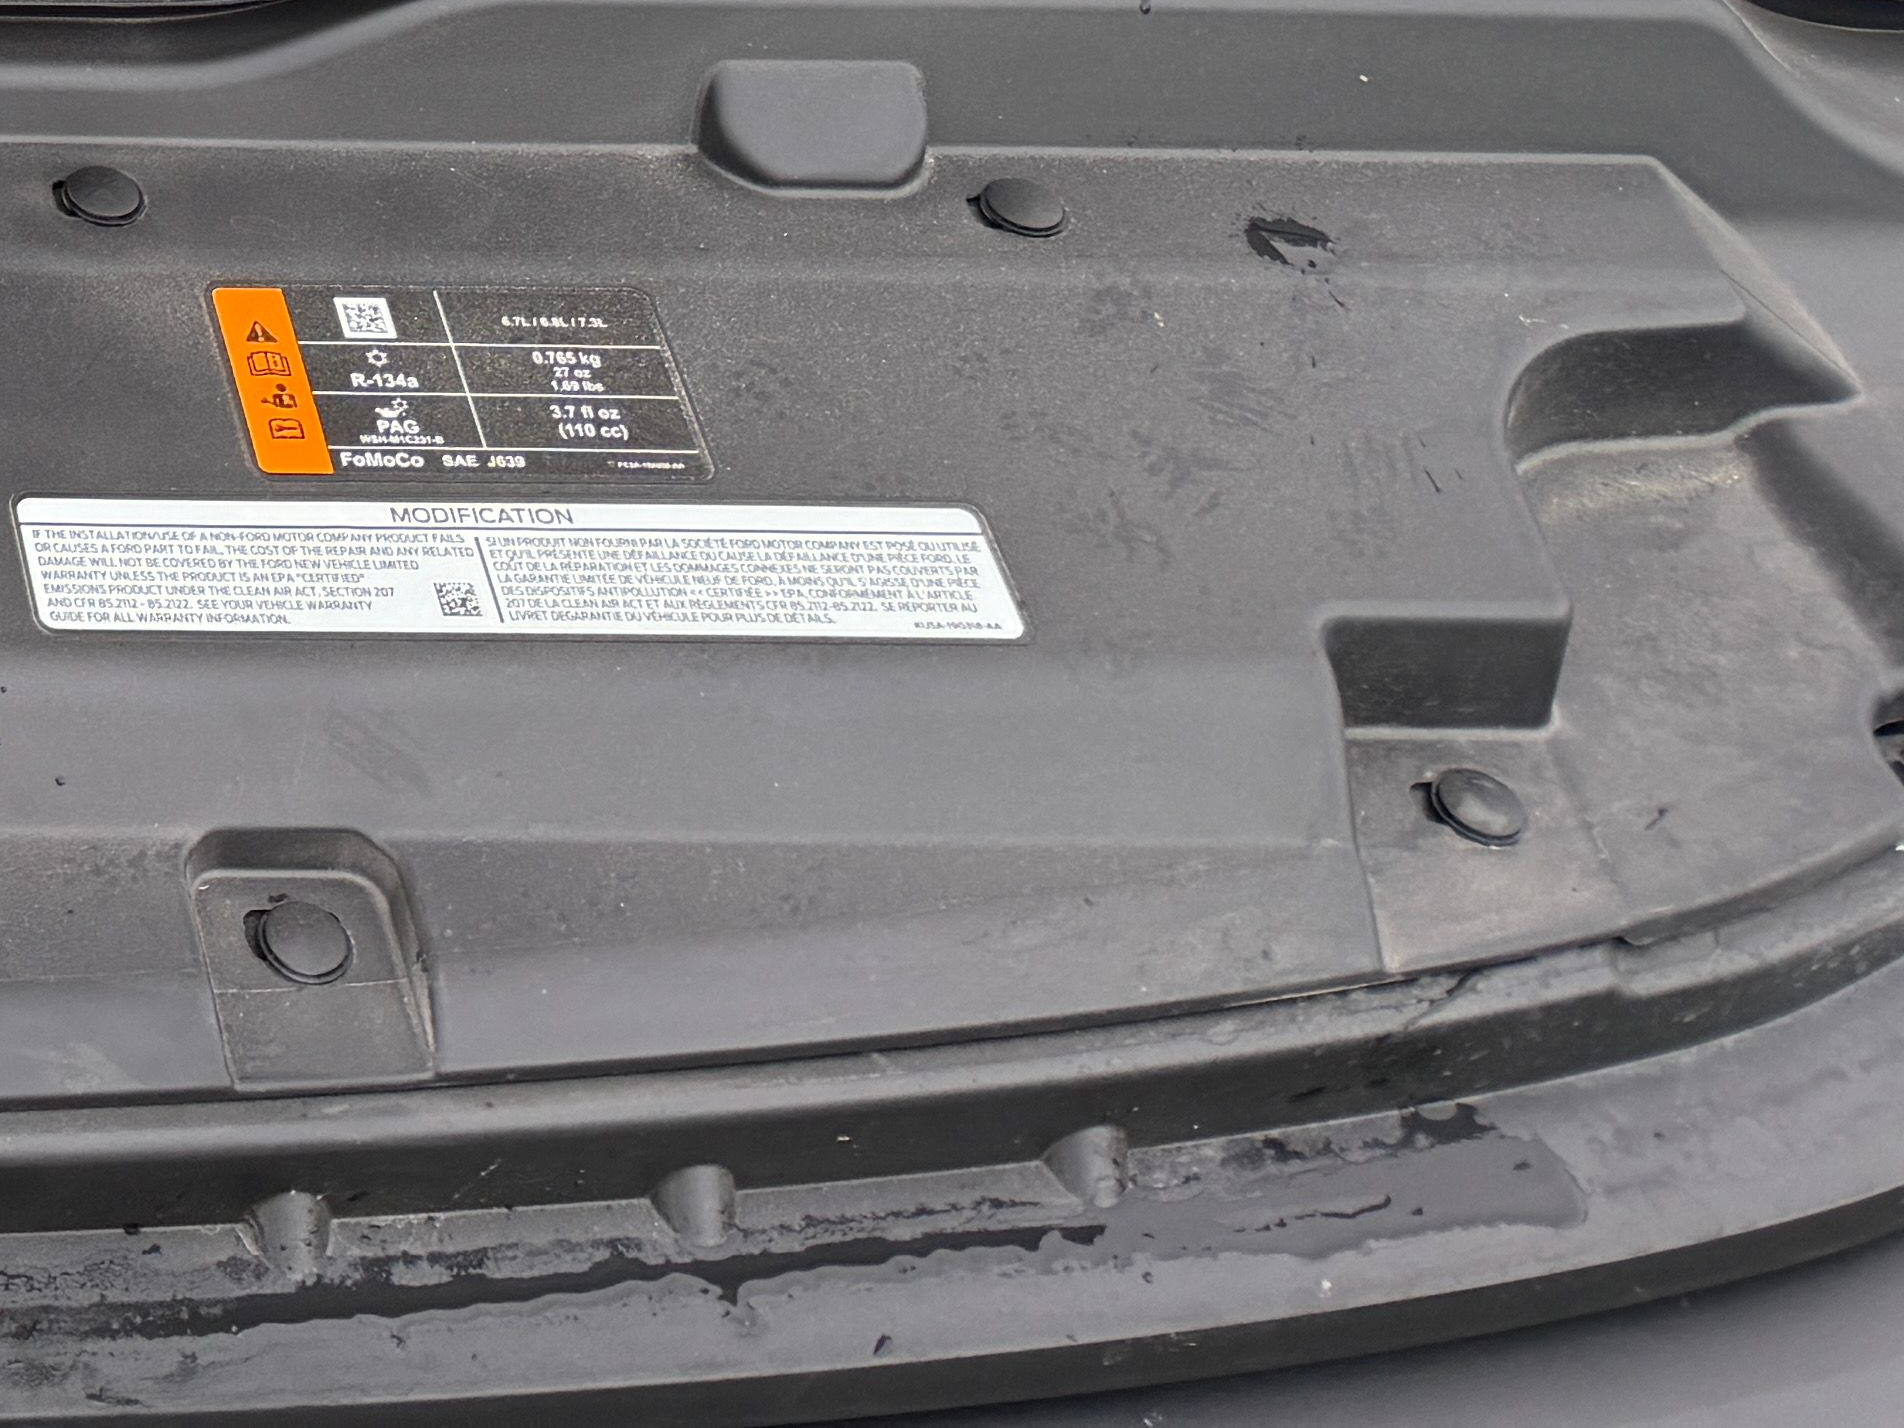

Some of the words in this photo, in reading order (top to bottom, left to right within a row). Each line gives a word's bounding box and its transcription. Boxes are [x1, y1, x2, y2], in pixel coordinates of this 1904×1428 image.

[532, 351, 575, 365] 0.765
[580, 352, 601, 369] kg
[553, 368, 567, 377] 27
[572, 370, 591, 378] oz
[351, 373, 419, 389] R-134a
[583, 380, 604, 392] lbs
[551, 405, 575, 419] 3.7
[581, 405, 592, 419] fl
[598, 409, 620, 419] oz
[377, 420, 420, 434] PAG
[558, 423, 593, 440] (110
[599, 424, 629, 440] cc)
[341, 452, 425, 468] FoMoCo
[442, 453, 478, 467] SAE
[487, 454, 526, 468] J639
[391, 507, 574, 525] MODIFICATION
[31, 530, 42, 540] IF
[45, 530, 67, 540] THE
[181, 531, 197, 541] OF
[198, 531, 208, 541] A
[209, 531, 271, 542] NON-FORD
[272, 532, 314, 542] MOTOR
[315, 532, 373, 542] COMPANY
[375, 532, 429, 543] PRODUCT
[431, 533, 465, 543] FAILS
[34, 543, 51, 553] OR
[52, 543, 98, 553] CAUSES
[100, 543, 109, 553] A
[110, 543, 142, 554] FORD
[143, 544, 176, 554] PART
[178, 544, 193, 554] TO
[225, 544, 247, 555] THE
[250, 545, 280, 555] COST
[281, 545, 298, 555] OF
[300, 545, 323, 555] THE
[324, 545, 366, 556] REPAIR
[368, 546, 393, 556] AND
[395, 546, 419, 556] ANY
[421, 546, 474, 557] RELATED
[37, 557, 86, 567] DAMAGE
[88, 557, 116, 567] WILL
[118, 558, 143, 568] NOT
[145, 558, 161, 568] BE
[162, 558, 216, 568] COVERED
[217, 559, 233, 569] BY
[237, 559, 258, 569] THE
[260, 559, 292, 569] FORD
[294, 559, 320, 569] NEW
[324, 560, 371, 570] VEHICLE
[372, 560, 419, 570] LIMITED
[40, 570, 107, 581] WARRANTY
[109, 571, 155, 581] UNLESS
[157, 571, 180, 581] THE
[181, 572, 236, 582] PRODUCT
[238, 572, 250, 582] IS
[251, 572, 269, 582] AN
[271, 572, 295, 582] EPA
[43, 584, 106, 594] EMISSIONS
[108, 585, 163, 595] PRODUCT
[165, 585, 206, 595] UNDER
[208, 585, 231, 596] THE
[232, 586, 271, 596] CLEAN
[272, 586, 292, 596] AIR
[321, 586, 371, 597] SECTION
[373, 587, 395, 597] 207
[46, 598, 72, 608] AND
[73, 598, 96, 608] CFR
[196, 599, 219, 609] SEE
[221, 599, 254, 610] YOUR
[255, 600, 304, 610] VEHICLE
[305, 600, 373, 611] WARRANTY
[49, 612, 85, 622] GUIDE
[87, 612, 110, 622] FOR
[112, 612, 134, 623] ALL
[136, 613, 203, 623] WARRANTY
